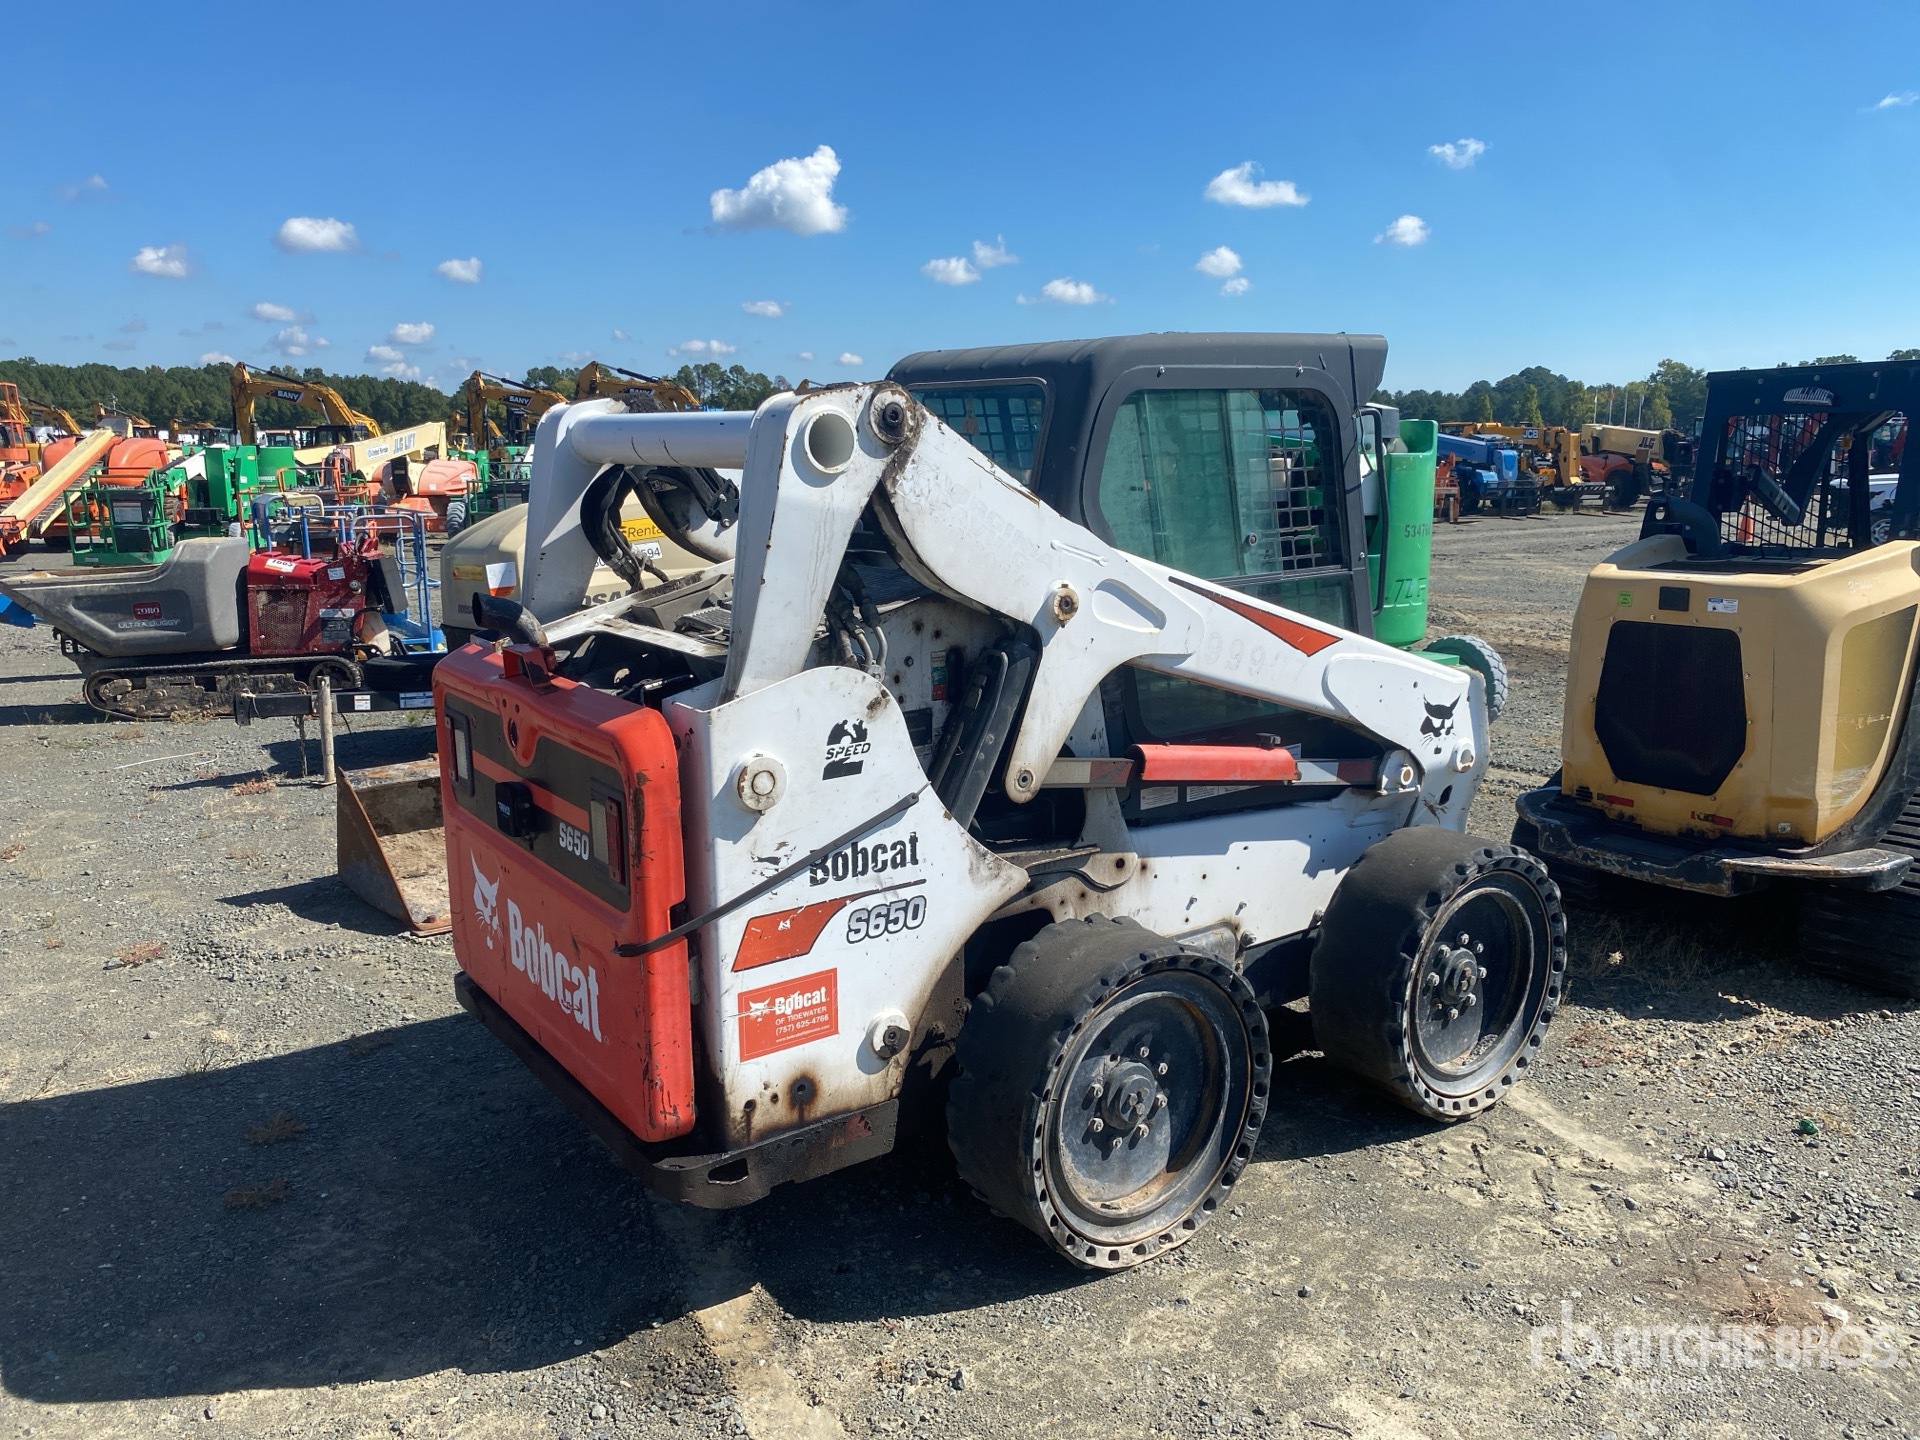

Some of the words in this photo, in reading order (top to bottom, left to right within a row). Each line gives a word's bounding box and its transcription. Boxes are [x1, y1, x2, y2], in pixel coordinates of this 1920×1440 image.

[277, 390, 298, 400] SANY
[509, 395, 530, 405] SANY
[1523, 429, 1539, 439] JCB
[1638, 437, 1656, 450] JLG
[118, 621, 148, 629] ULTRA
[149, 619, 180, 627] BUGGY
[825, 742, 871, 760] SPEED
[559, 822, 590, 861] S650
[810, 831, 919, 887] Bobcat
[846, 895, 927, 944] S650
[507, 898, 602, 1043] Bobcat
[775, 986, 827, 1015] Bobcat
[775, 1017, 786, 1026] OF
[787, 1006, 827, 1023] TIDEWATER
[775, 1022, 795, 1036] (757)
